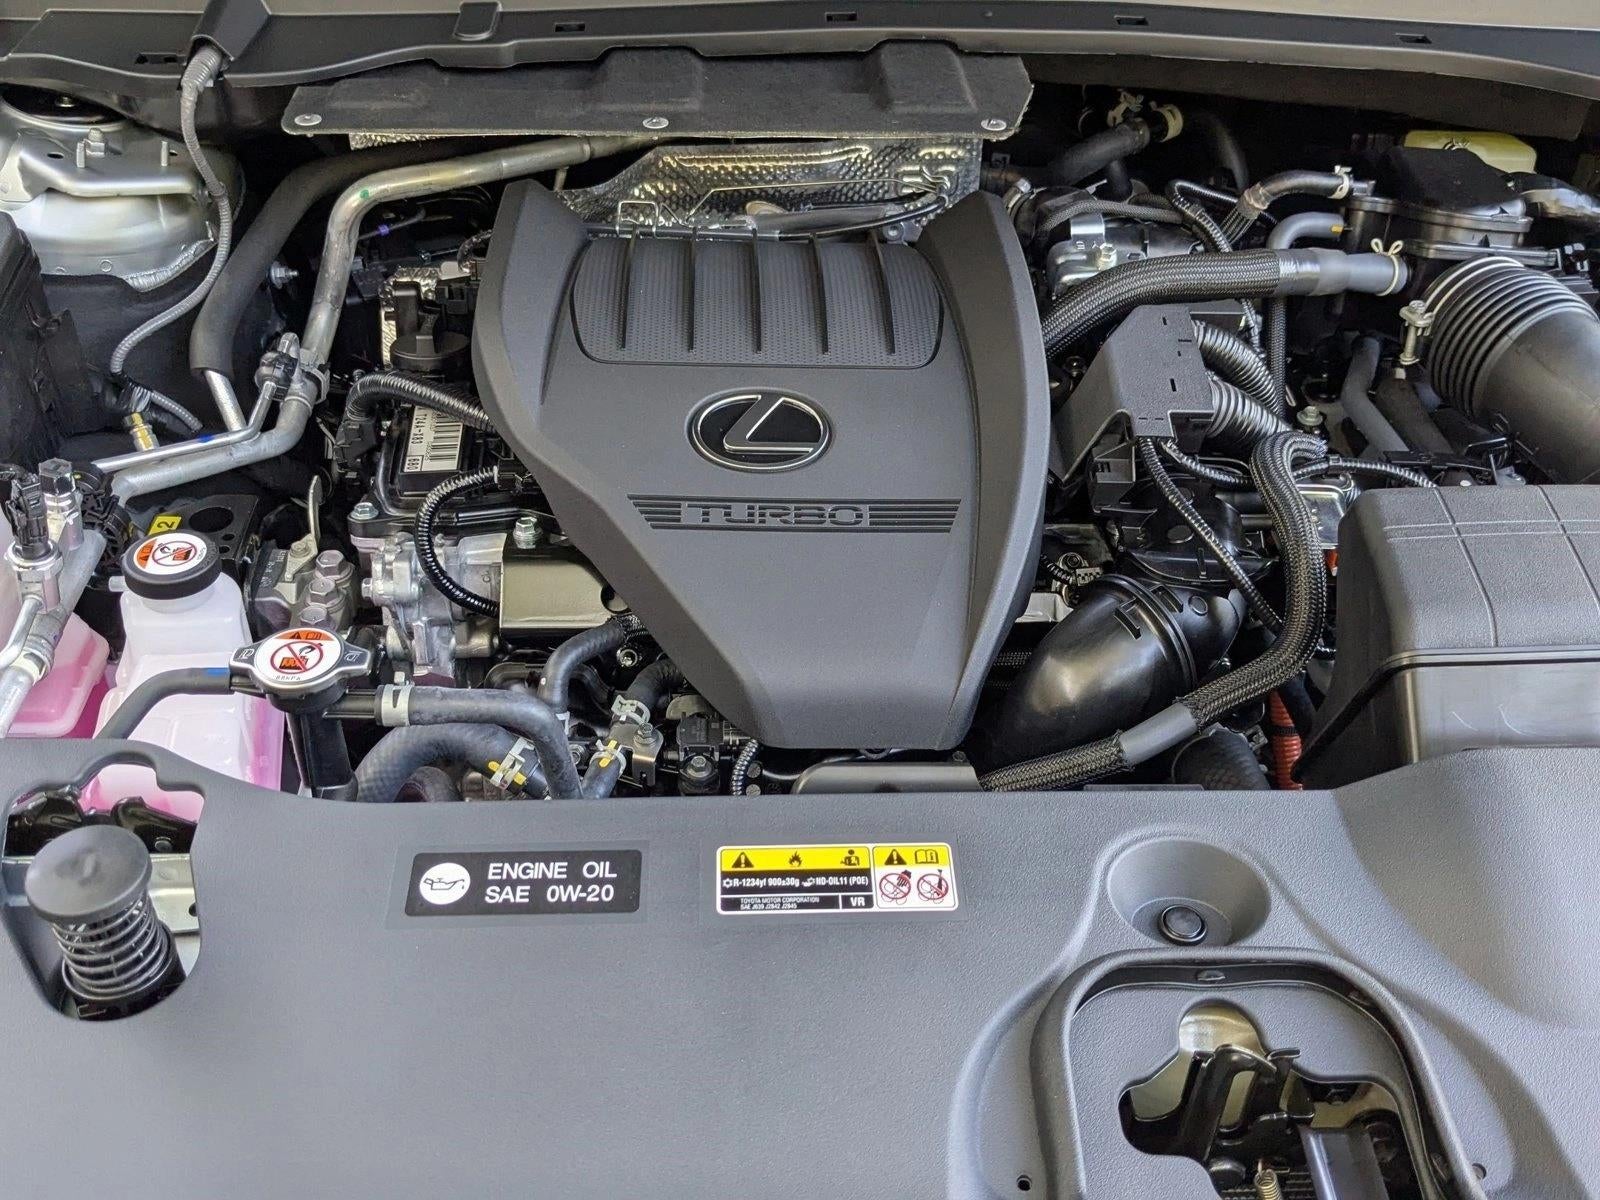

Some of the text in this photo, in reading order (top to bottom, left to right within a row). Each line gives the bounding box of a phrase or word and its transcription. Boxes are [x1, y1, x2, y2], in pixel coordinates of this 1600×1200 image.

[685, 503, 864, 526] TURBO
[487, 860, 617, 880] ENGINE OIL
[733, 877, 766, 888] R-1234yf
[849, 876, 869, 886] (POE)
[484, 884, 615, 903] SAE 0W-20
[850, 896, 866, 907] VR
